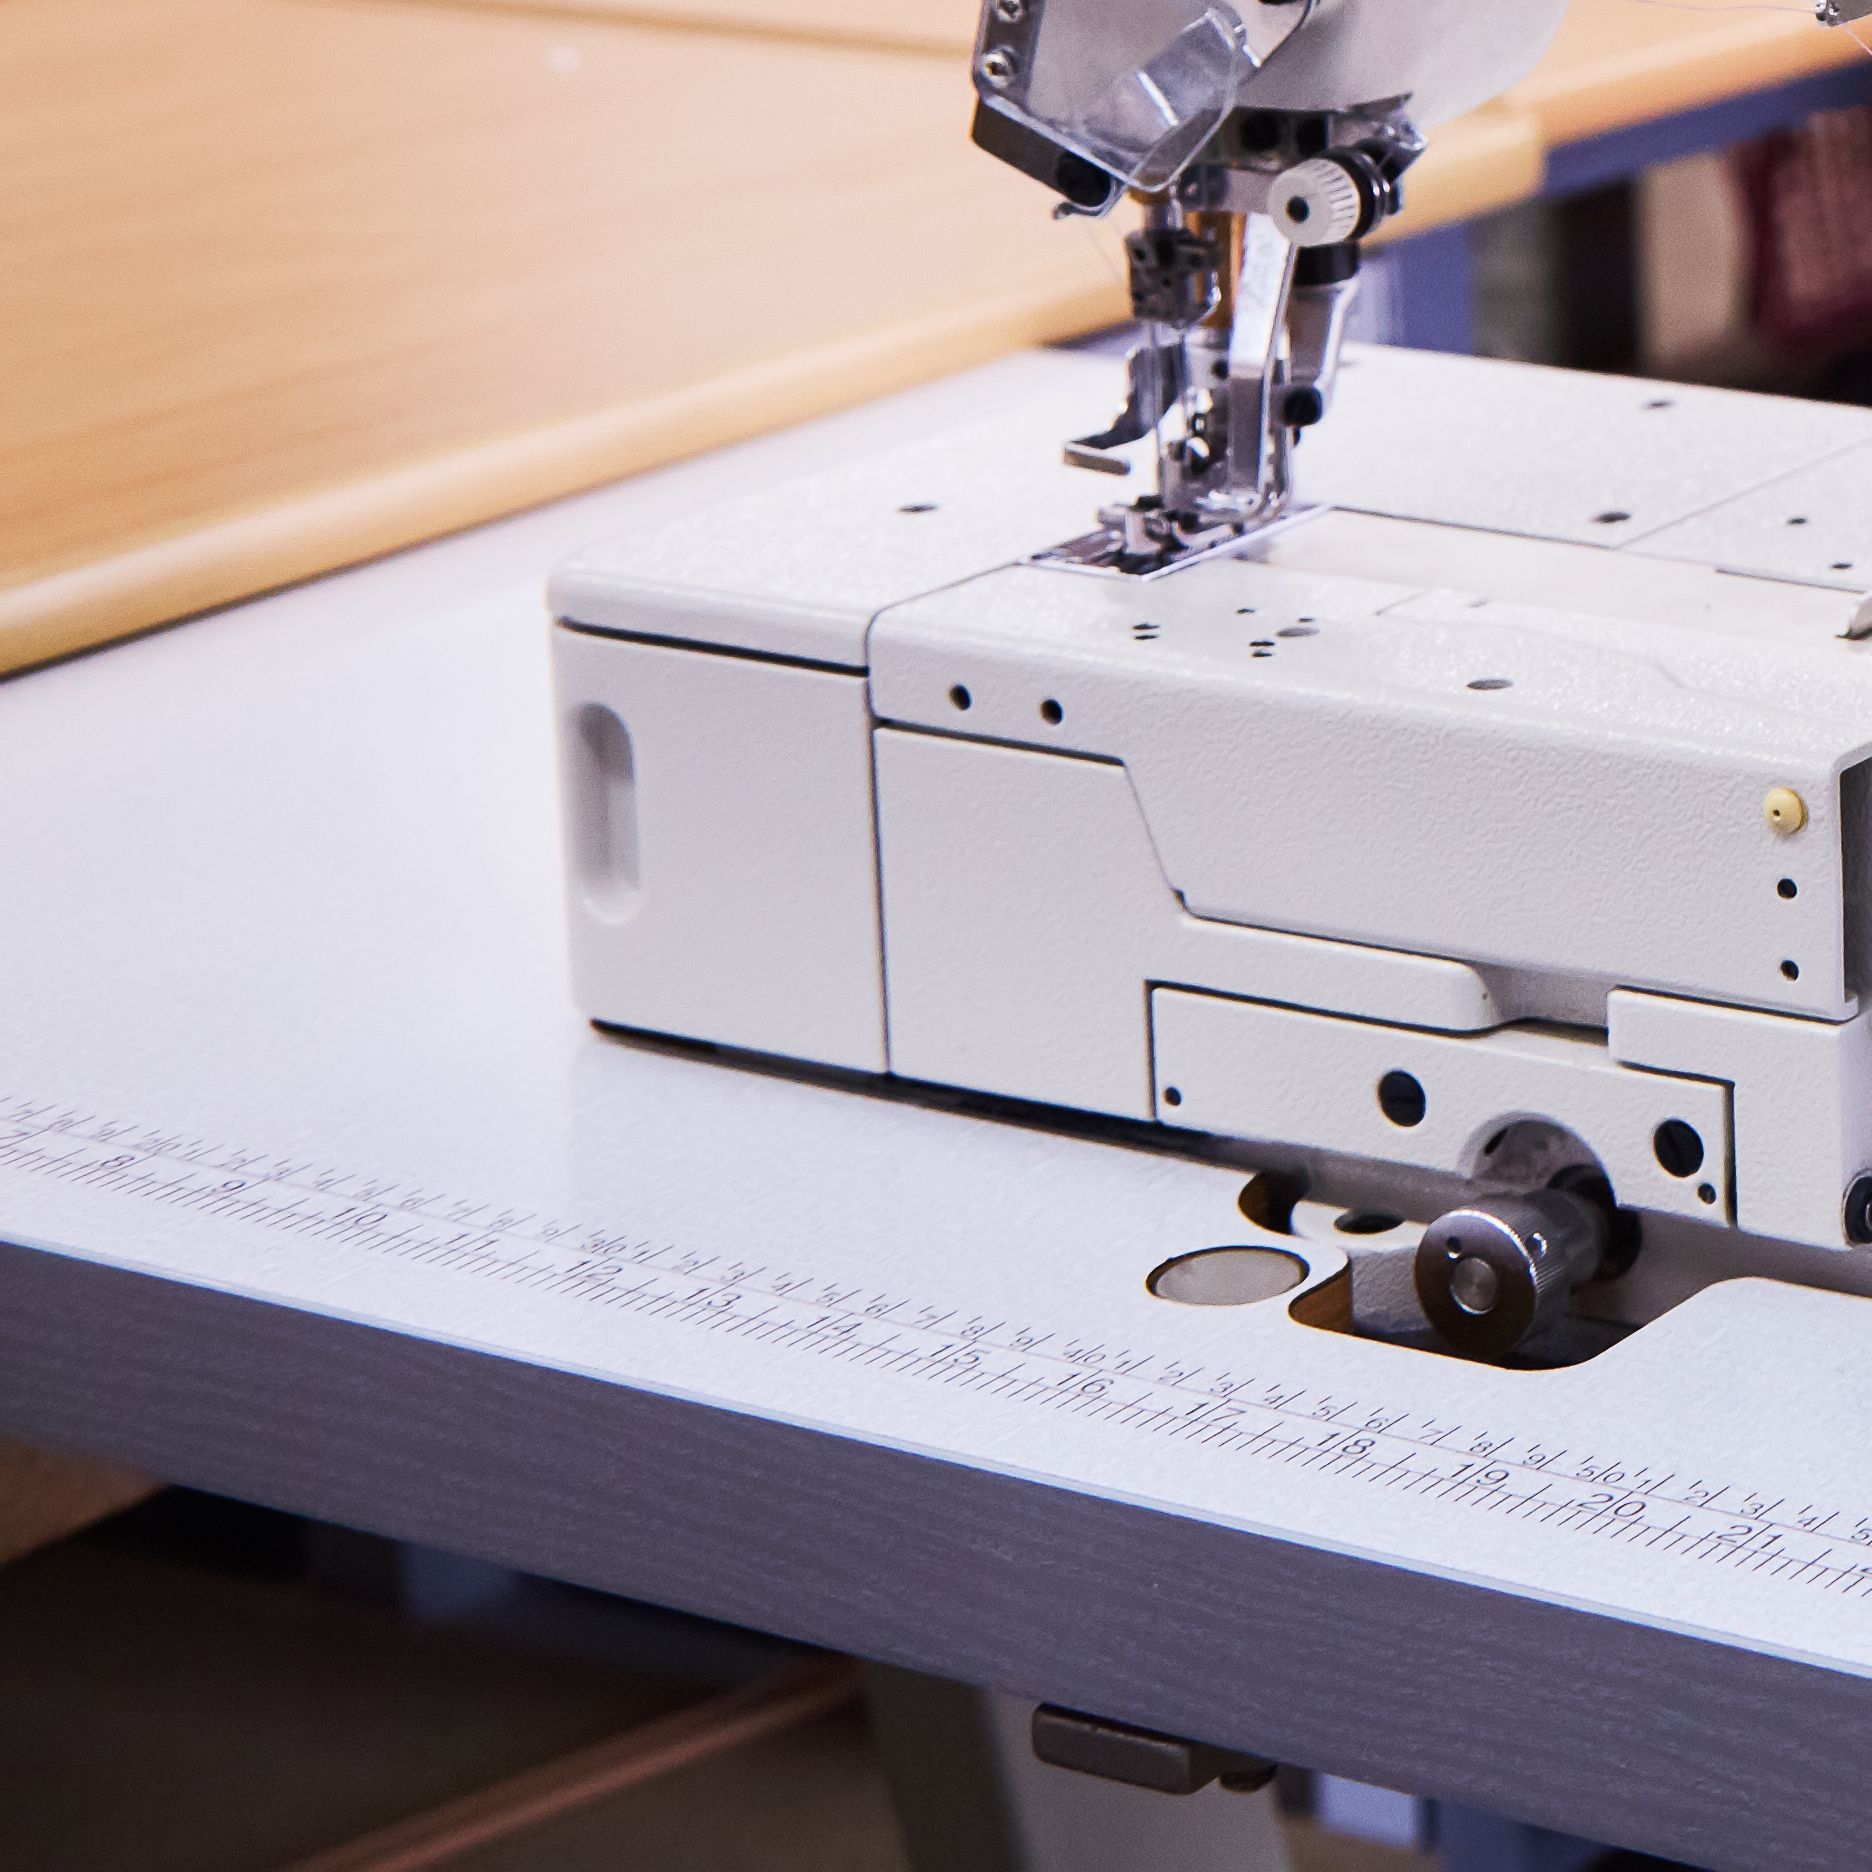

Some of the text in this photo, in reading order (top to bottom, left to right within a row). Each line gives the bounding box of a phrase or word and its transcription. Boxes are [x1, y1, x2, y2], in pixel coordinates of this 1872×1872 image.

[99, 1154, 135, 1169] 8
[210, 1179, 246, 1195] 9
[331, 1207, 388, 1227] 10
[445, 1233, 499, 1252] 11
[565, 1260, 623, 1278] 12
[685, 1287, 742, 1308] 13
[806, 1315, 863, 1337] 14
[930, 1344, 991, 1365] 15
[1056, 1372, 1115, 1394] 16
[1185, 1401, 1248, 1422] 17
[1316, 1432, 1377, 1456] 18
[1451, 1463, 1510, 1486] 19
[1576, 1493, 1647, 1518] 20
[1716, 1524, 1784, 1549] 21
[1009, 1336, 1034, 1348] 9
[1063, 1348, 1107, 1365] 40
[1115, 1359, 1132, 1370] 1
[1159, 1369, 1184, 1381] 2
[1210, 1381, 1234, 1394] 3
[1264, 1394, 1285, 1405] 4
[1312, 1404, 1338, 1418] 5
[1364, 1416, 1390, 1429] 6
[1419, 1428, 1443, 1440] 7
[1469, 1440, 1493, 1453] 8
[1522, 1452, 1546, 1466] 9
[1576, 1465, 1626, 1483] 50
[1636, 1479, 1652, 1489] 1
[1684, 1489, 1709, 1502] 2
[1740, 1502, 1765, 1515] 3
[1797, 1516, 1818, 1528] 4
